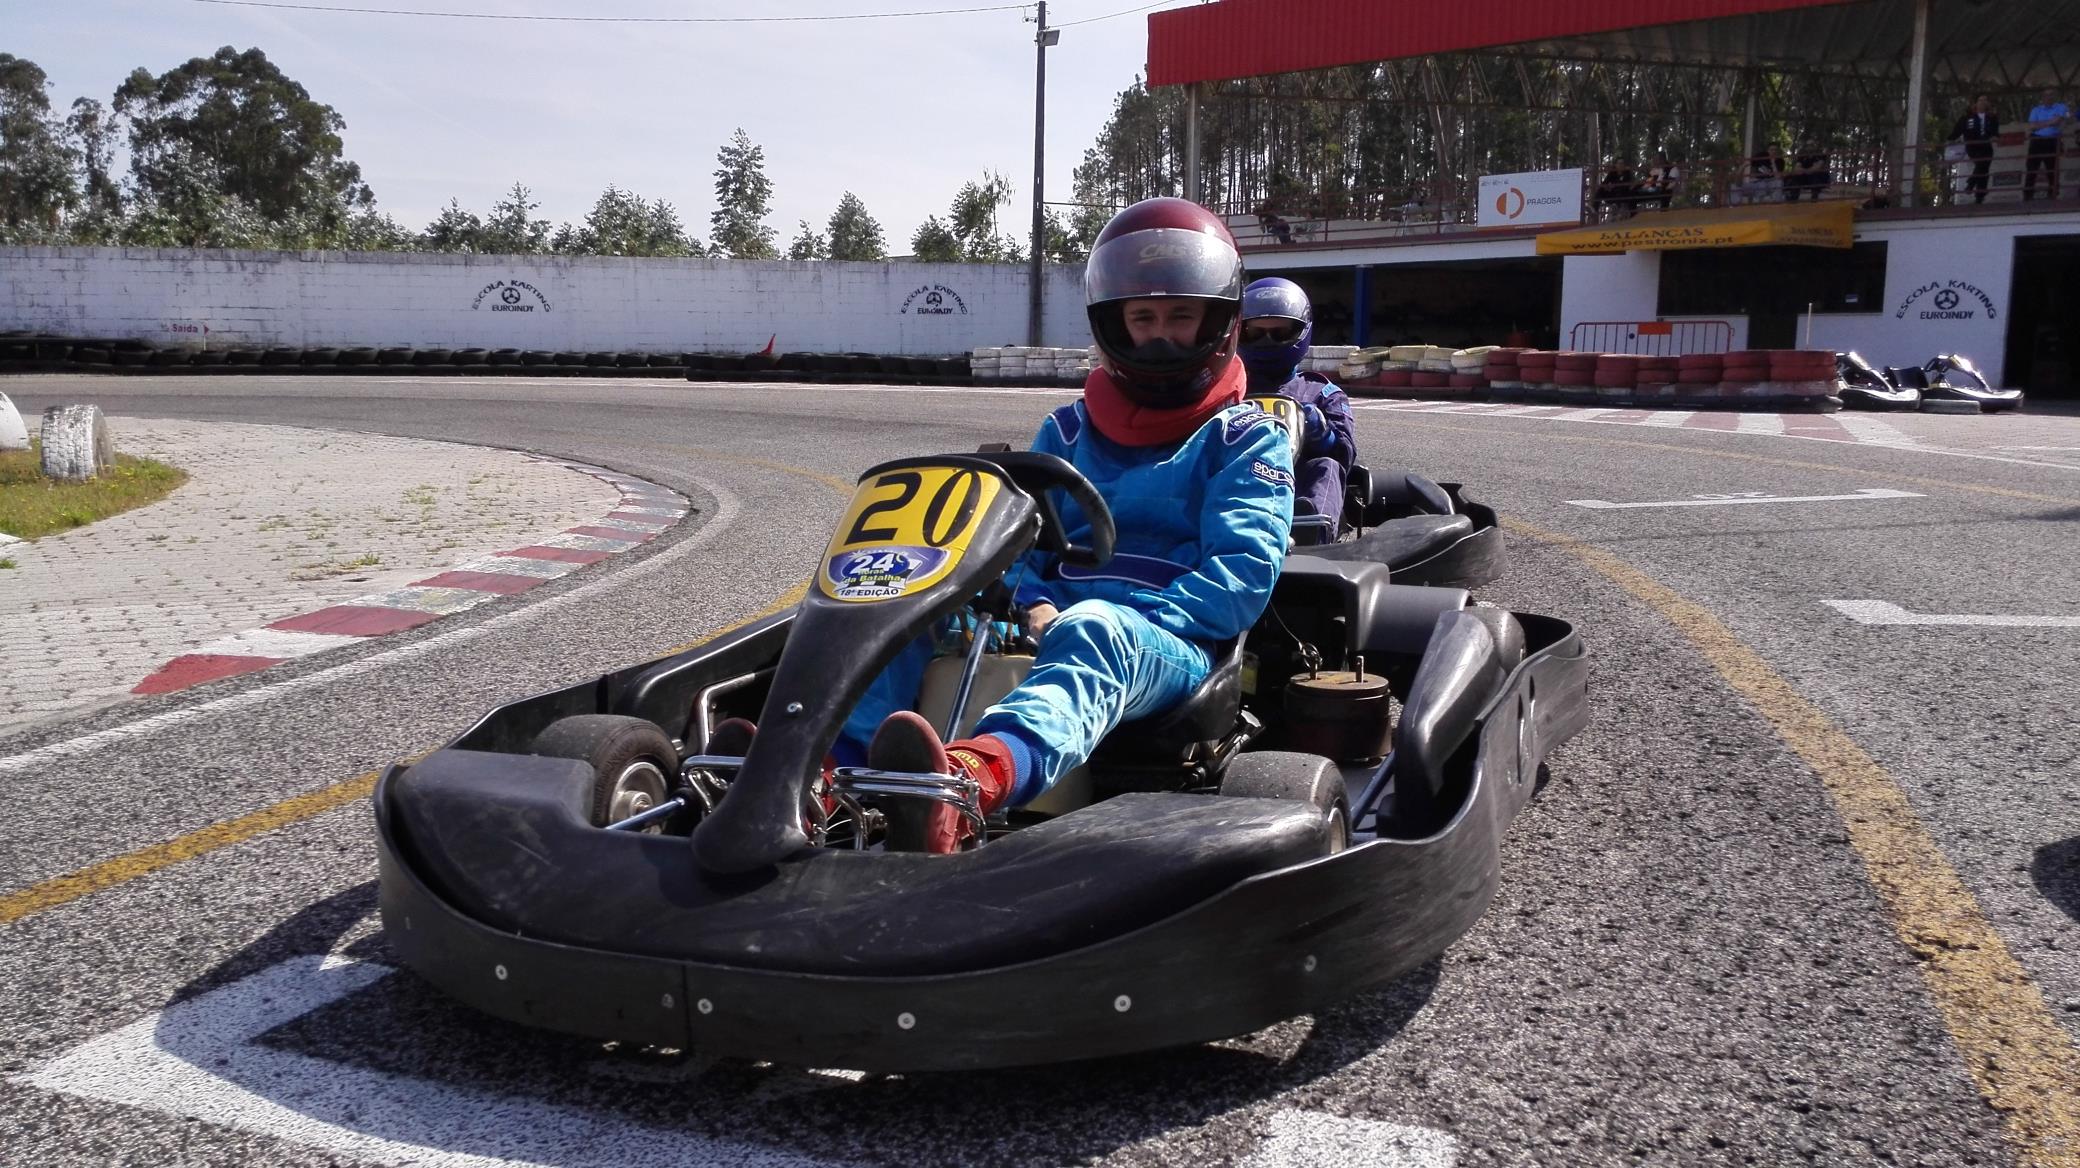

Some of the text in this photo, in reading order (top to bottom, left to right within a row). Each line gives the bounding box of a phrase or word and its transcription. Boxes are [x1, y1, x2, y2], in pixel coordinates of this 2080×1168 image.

[1526, 197, 1562, 205] PRAGOSA
[1571, 236, 1733, 249] www.pestronix.pt
[472, 280, 552, 312] ESCOLA KARTING
[901, 284, 968, 315] ESCOLA KARTING
[1896, 280, 1997, 319] ESCOLA KARTING
[492, 304, 534, 312] EUROINDY
[1920, 311, 1974, 320] EUROINDY
[844, 469, 982, 547] 20
[849, 553, 895, 575] 24
[860, 574, 901, 582] Batalha
[857, 588, 899, 597] EDIÇÃO
